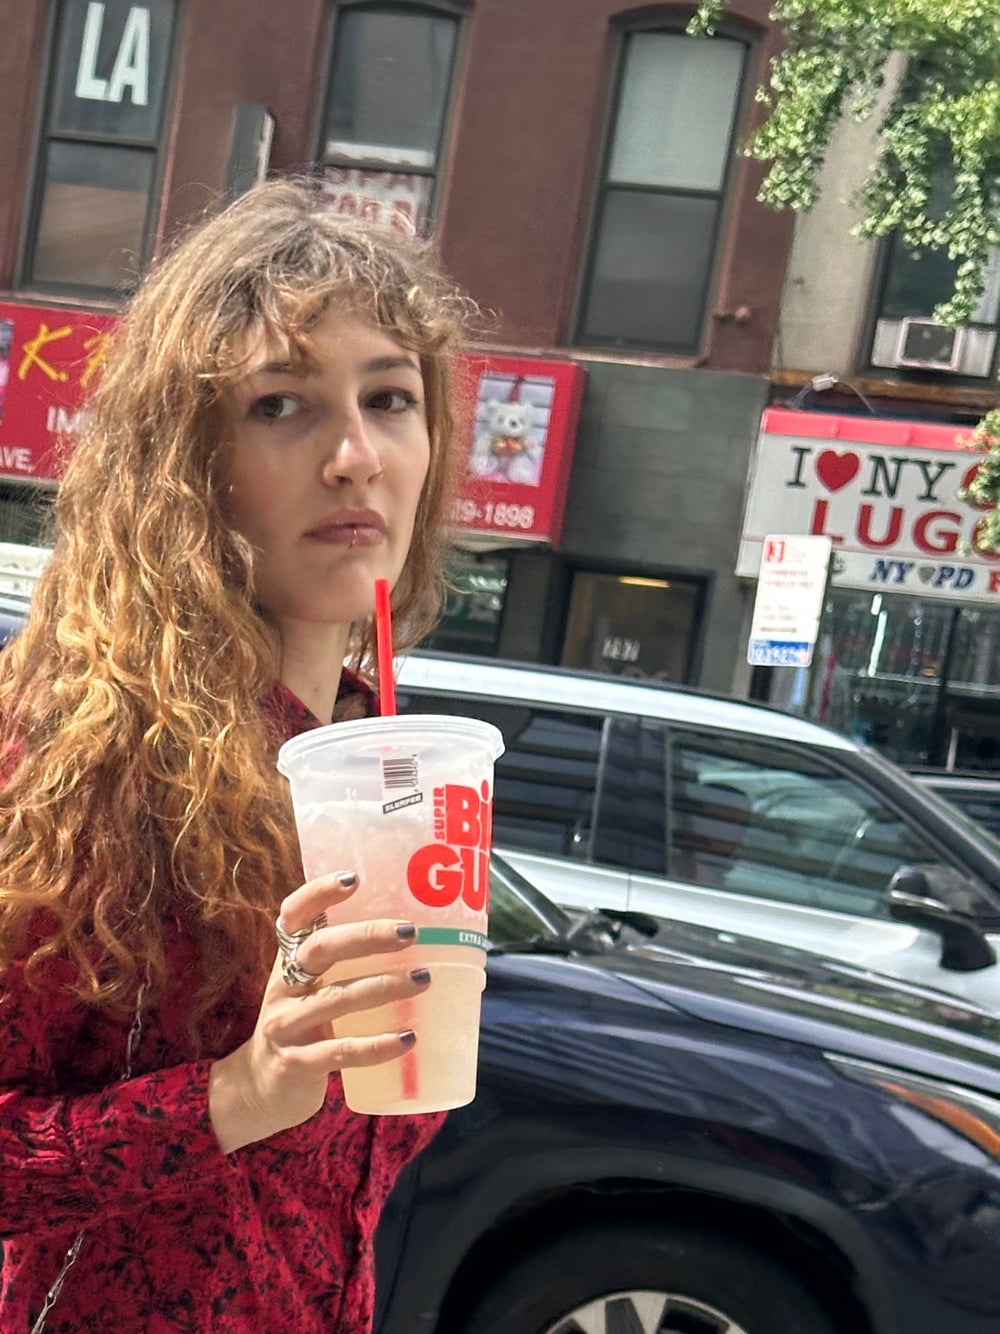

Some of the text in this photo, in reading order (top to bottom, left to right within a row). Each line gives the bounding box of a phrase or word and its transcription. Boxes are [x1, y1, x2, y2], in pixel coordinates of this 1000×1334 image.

[75, 2, 151, 106] LA
[433, 786, 446, 842] SUPER
[406, 843, 490, 914] GU
[459, 931, 482, 946] EXTRA
